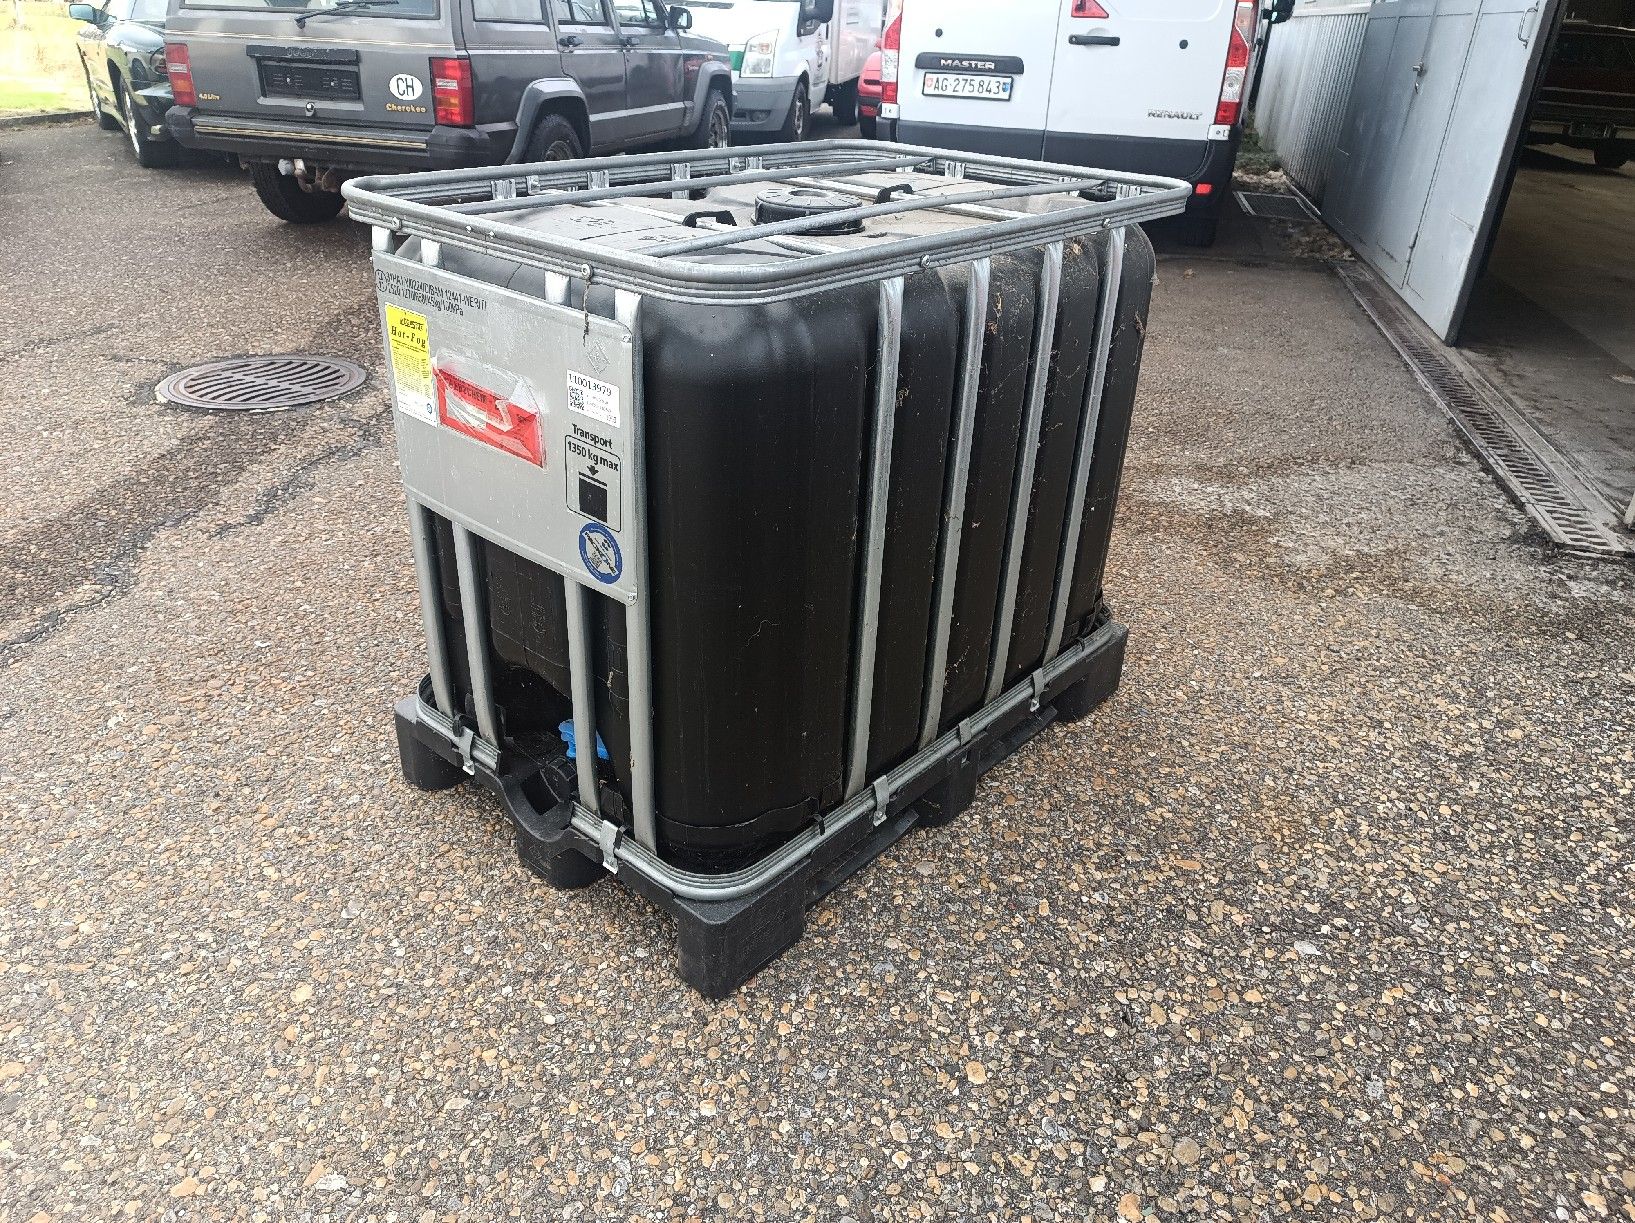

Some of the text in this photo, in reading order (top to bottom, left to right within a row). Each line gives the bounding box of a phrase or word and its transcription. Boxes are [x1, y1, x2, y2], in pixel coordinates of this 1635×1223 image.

[940, 59, 995, 69] MASTER
[396, 77, 415, 96] CH
[385, 103, 426, 112] Cherokee
[1147, 108, 1203, 120] RENAULT
[568, 374, 612, 397] 110013979
[572, 422, 612, 450] Transport
[567, 441, 619, 472] 1350 kg max
